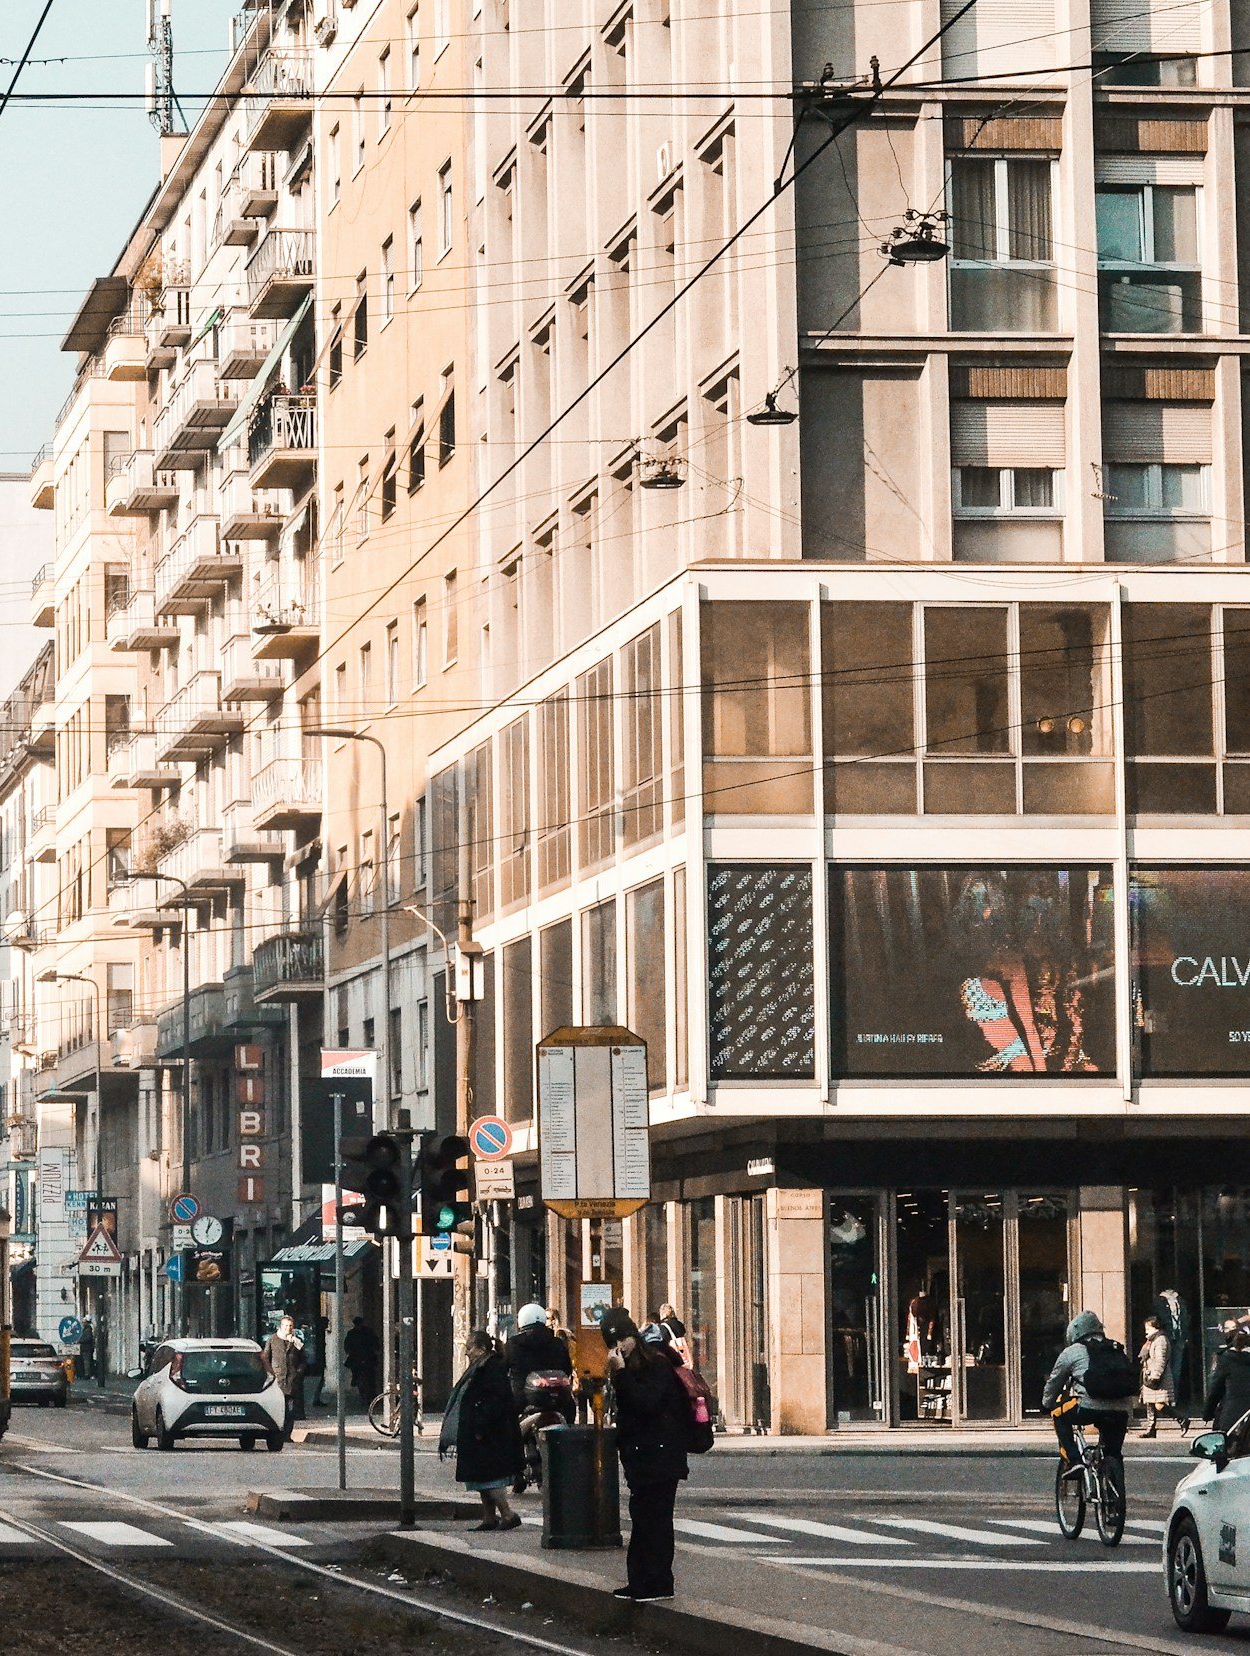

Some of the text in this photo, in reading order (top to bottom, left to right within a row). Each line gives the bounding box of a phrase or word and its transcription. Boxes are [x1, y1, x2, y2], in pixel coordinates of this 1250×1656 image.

[332, 1067, 367, 1075] ACCADEMIA
[240, 1045, 261, 1201] LIBRI
[484, 1167, 505, 1175] 0-24
[42, 1163, 62, 1204] PIZZIUM
